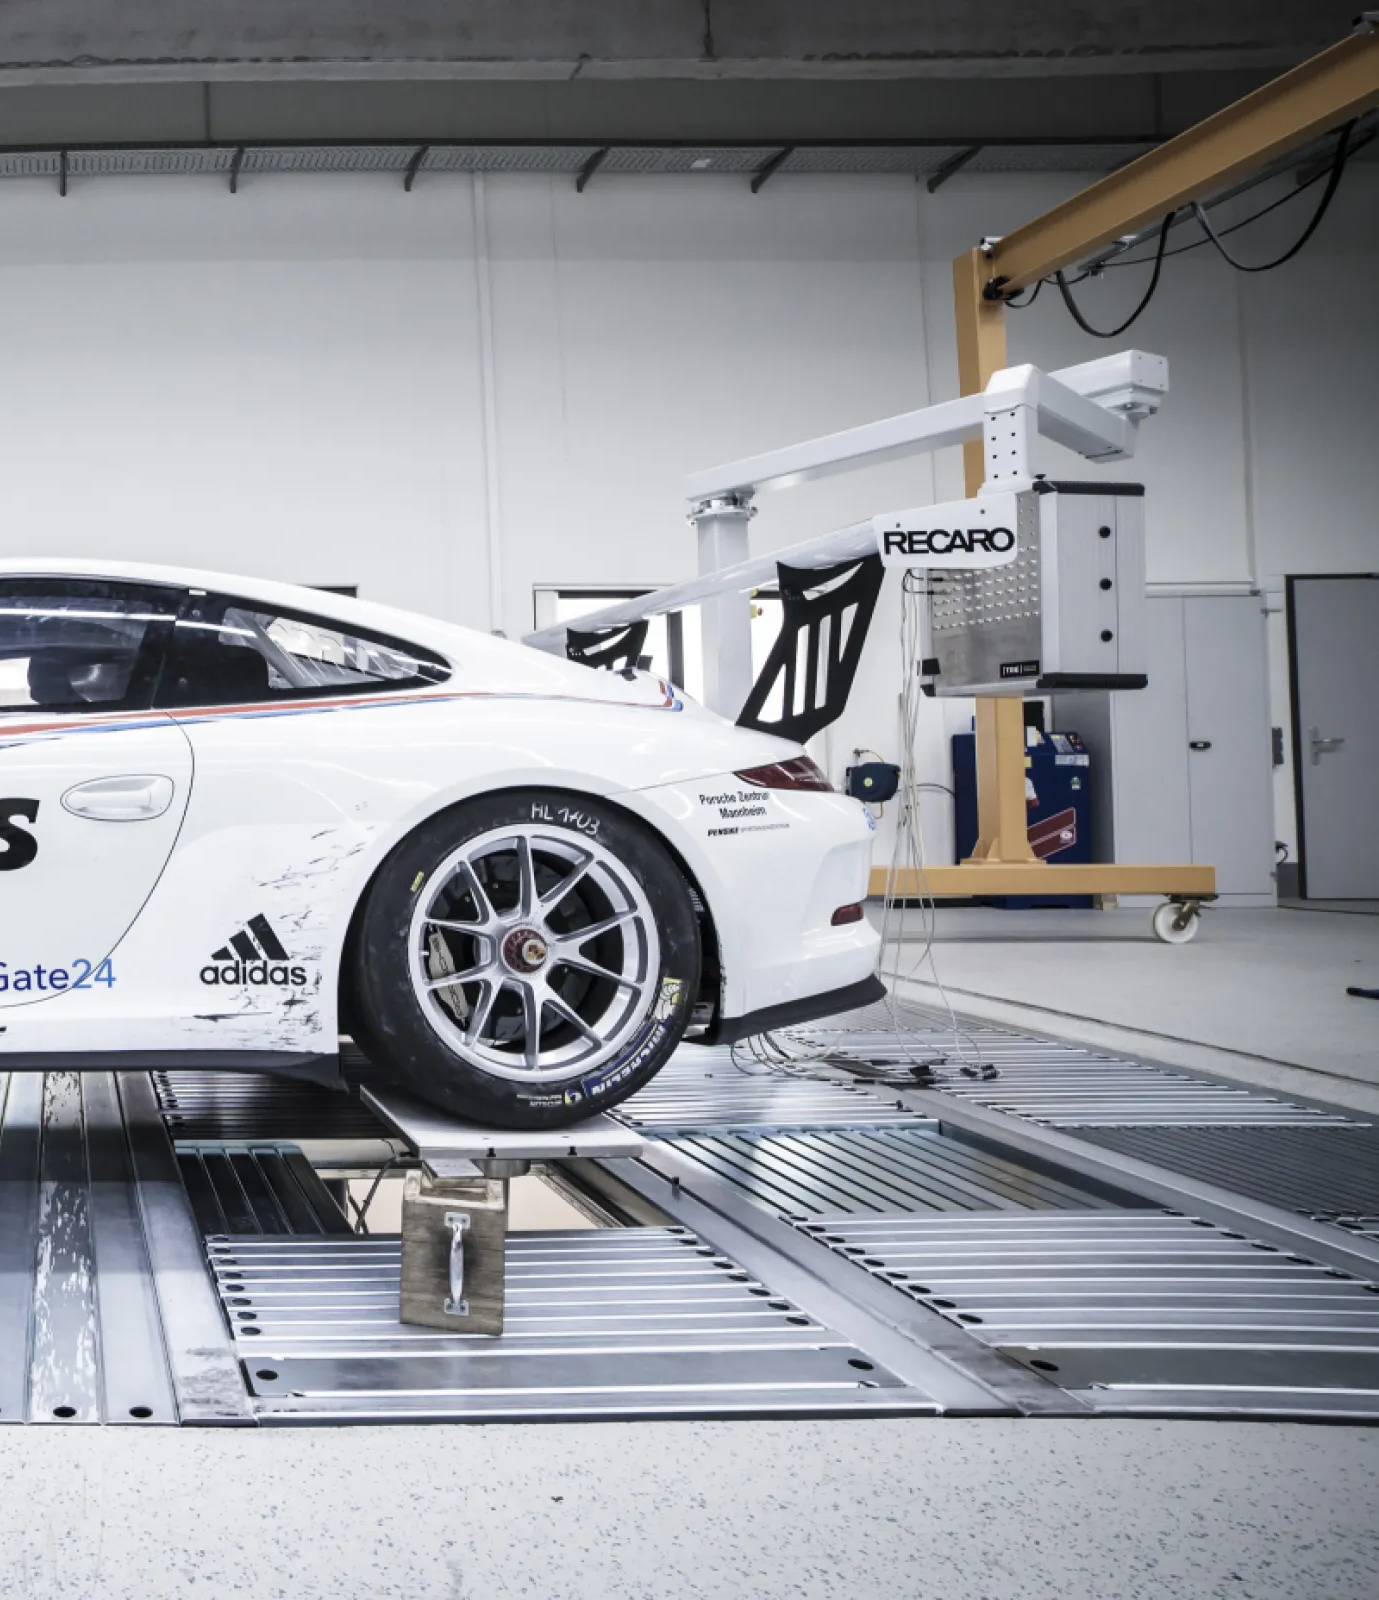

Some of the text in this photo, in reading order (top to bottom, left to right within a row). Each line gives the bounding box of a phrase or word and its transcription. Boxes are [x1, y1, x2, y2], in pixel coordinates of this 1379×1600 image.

[883, 527, 1015, 555] RECARO
[699, 792, 736, 805] Porsche
[531, 802, 553, 820] HL
[199, 959, 308, 986] adidas
